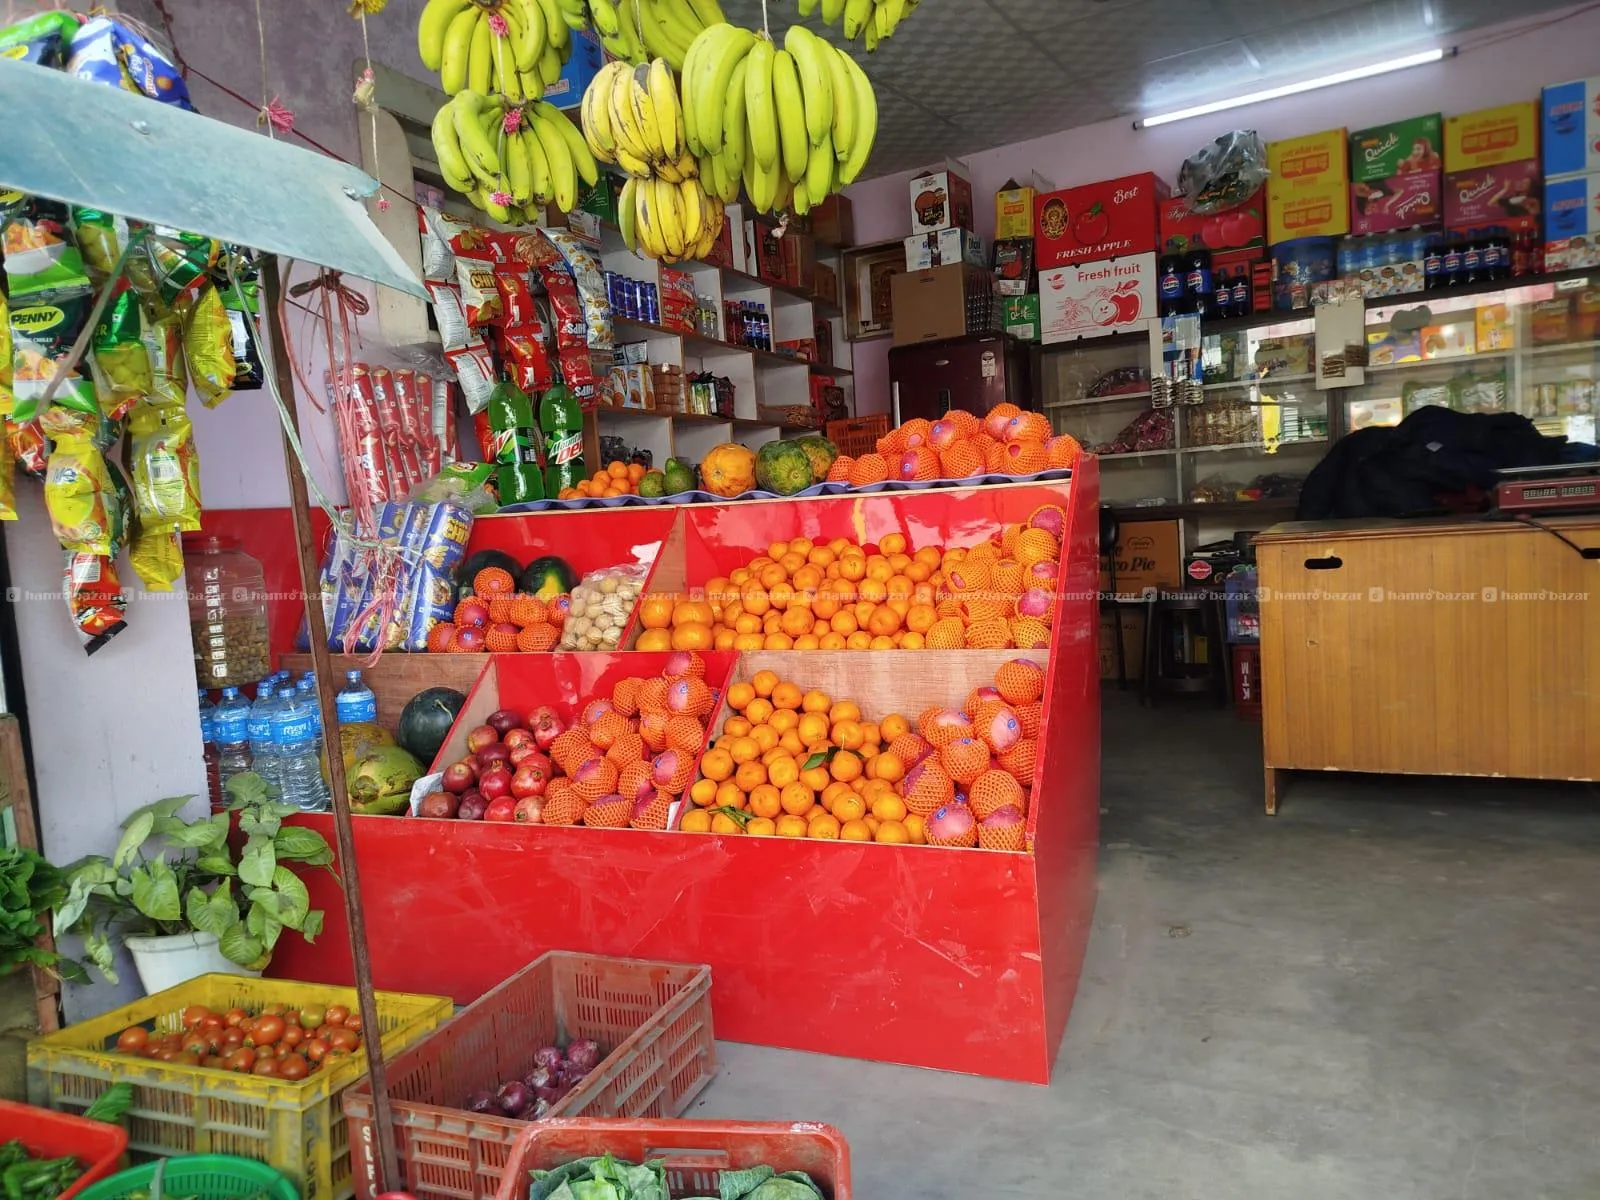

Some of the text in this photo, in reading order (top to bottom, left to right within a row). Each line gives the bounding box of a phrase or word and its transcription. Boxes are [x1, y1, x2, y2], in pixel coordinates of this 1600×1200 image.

[1364, 133, 1399, 161] Quick
[1113, 186, 1140, 203] Best
[1055, 239, 1133, 260] FRESH APPLE
[1077, 263, 1141, 283] Fresh fruit
[11, 311, 57, 325] PENNY
[1129, 557, 1157, 572] Pie
